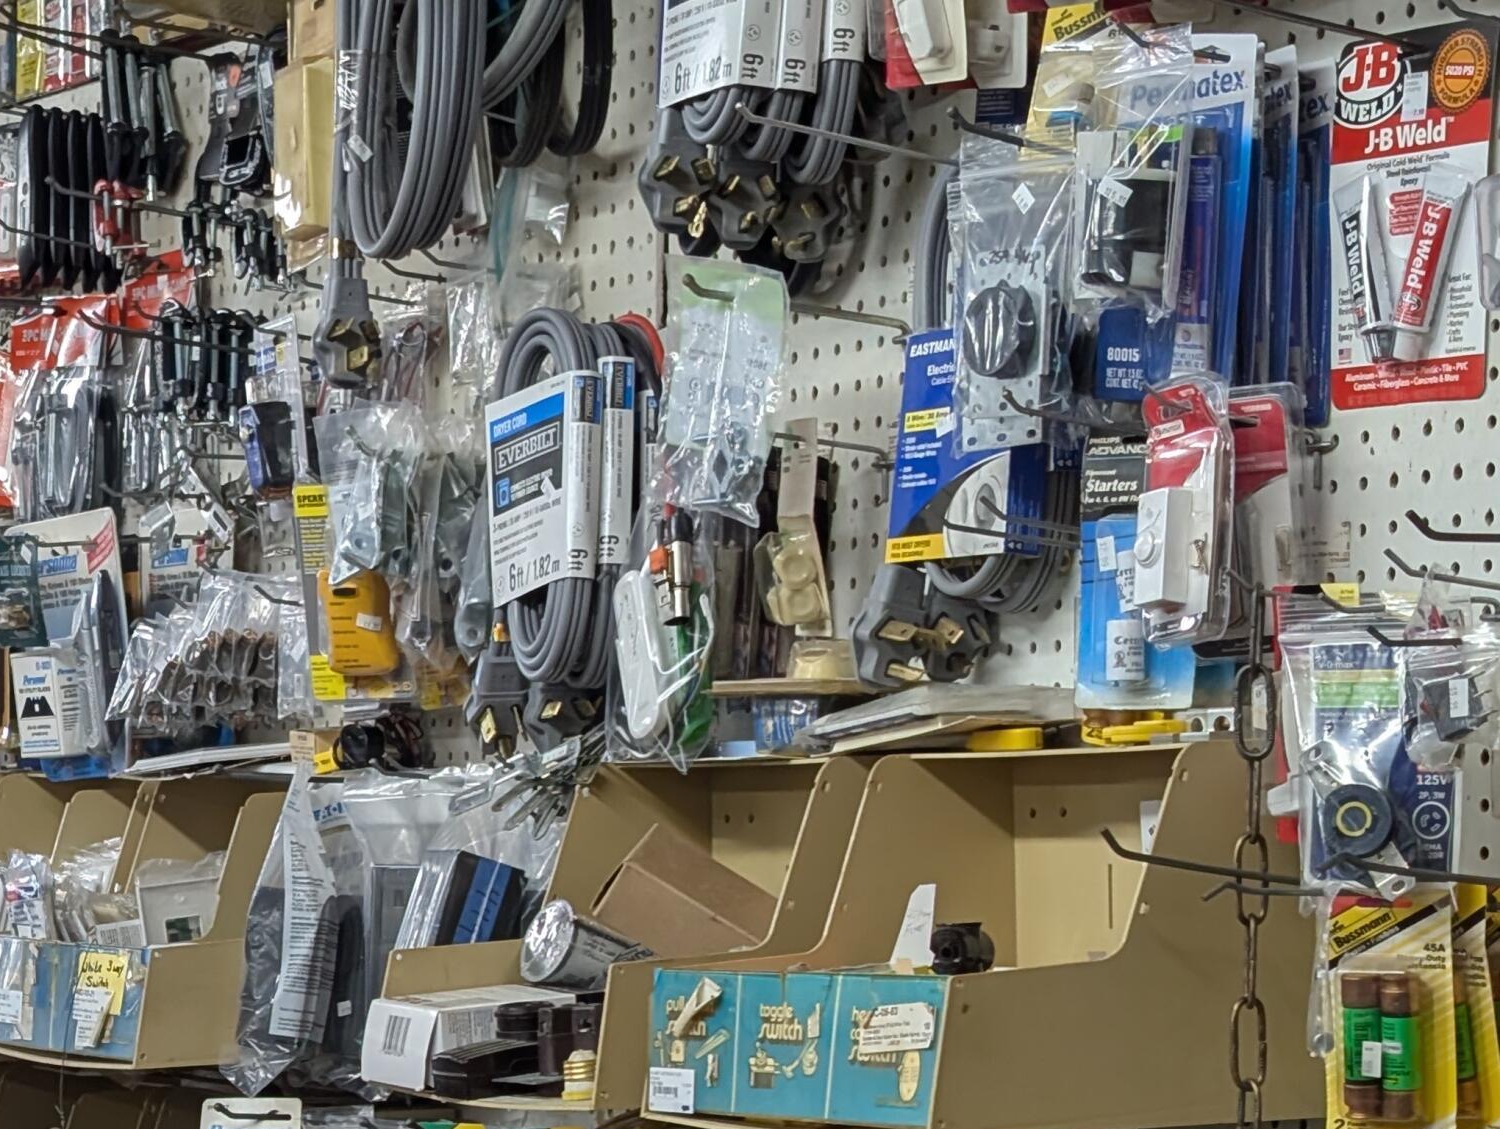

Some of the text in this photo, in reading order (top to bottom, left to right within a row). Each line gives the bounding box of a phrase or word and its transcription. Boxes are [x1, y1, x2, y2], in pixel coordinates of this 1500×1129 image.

[1339, 90, 1395, 123] WELD
[909, 337, 956, 358] EASTMAN
[1106, 346, 1140, 362] 80015
[496, 427, 558, 470] EVERBILT
[1088, 443, 1147, 457] ADVANC
[1084, 479, 1138, 493] Starters
[509, 562, 524, 592] 6ft
[1416, 775, 1449, 786] 125V
[1333, 911, 1393, 948] Bussmann
[759, 1002, 794, 1020] toggle
[758, 1019, 804, 1042] switch
